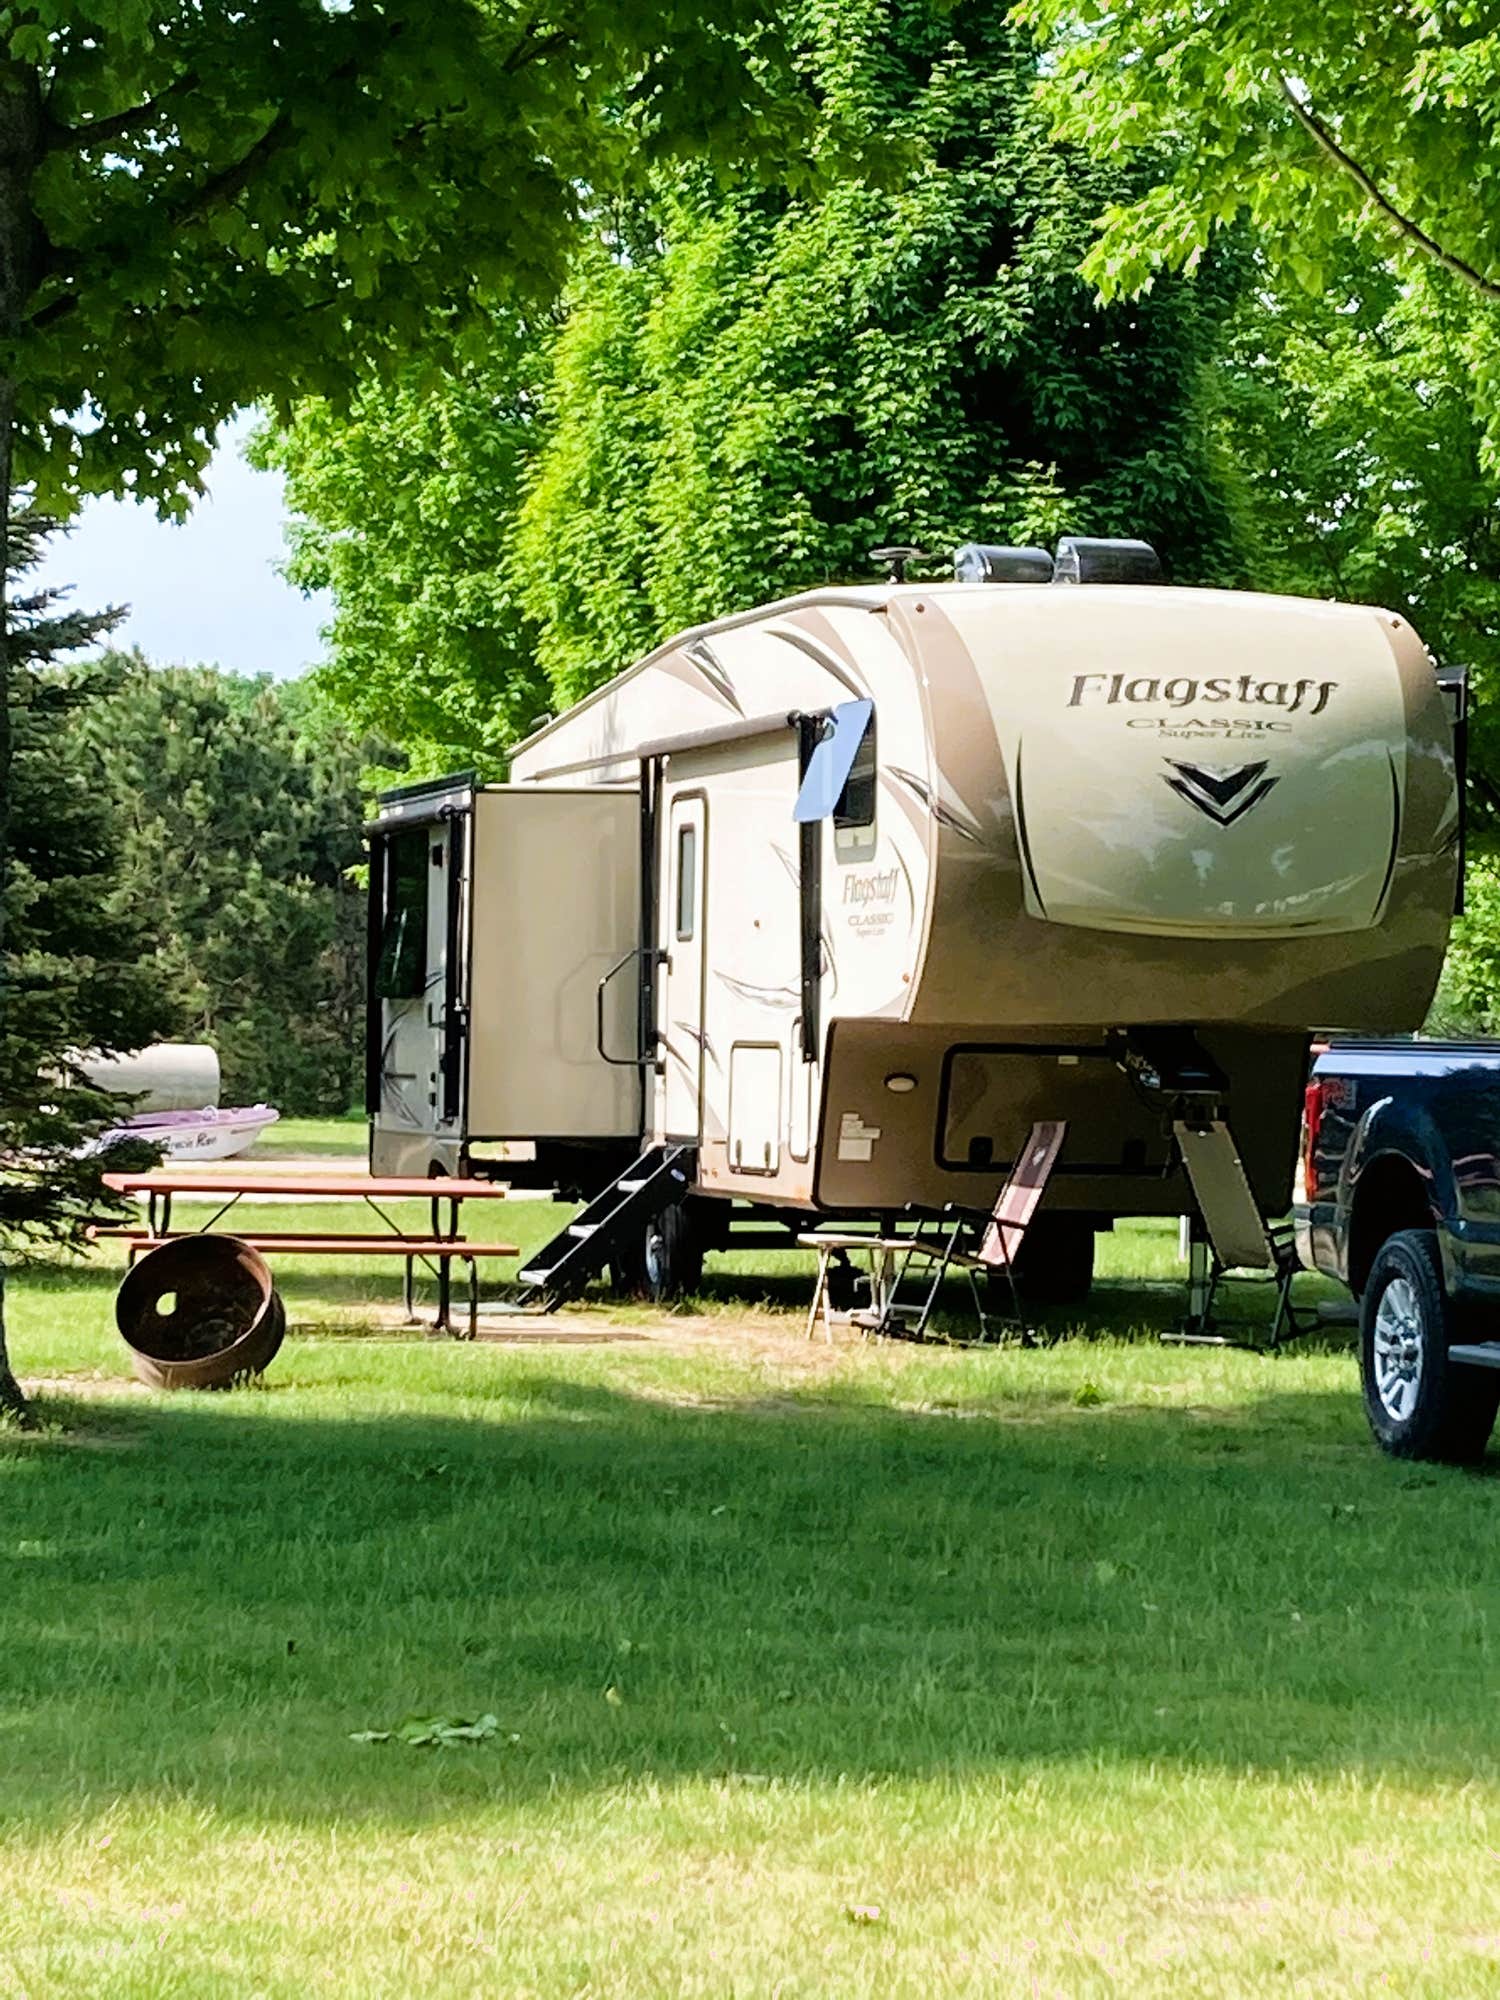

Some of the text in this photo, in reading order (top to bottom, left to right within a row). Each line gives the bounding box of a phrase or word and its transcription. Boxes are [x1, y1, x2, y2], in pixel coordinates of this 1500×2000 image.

[1066, 673, 1339, 715] Flagstaff
[1126, 718, 1293, 733] CLASSIC
[1158, 729, 1267, 740] Super Lite
[842, 867, 900, 909] Flagstaff
[847, 912, 894, 927] CLASSIC
